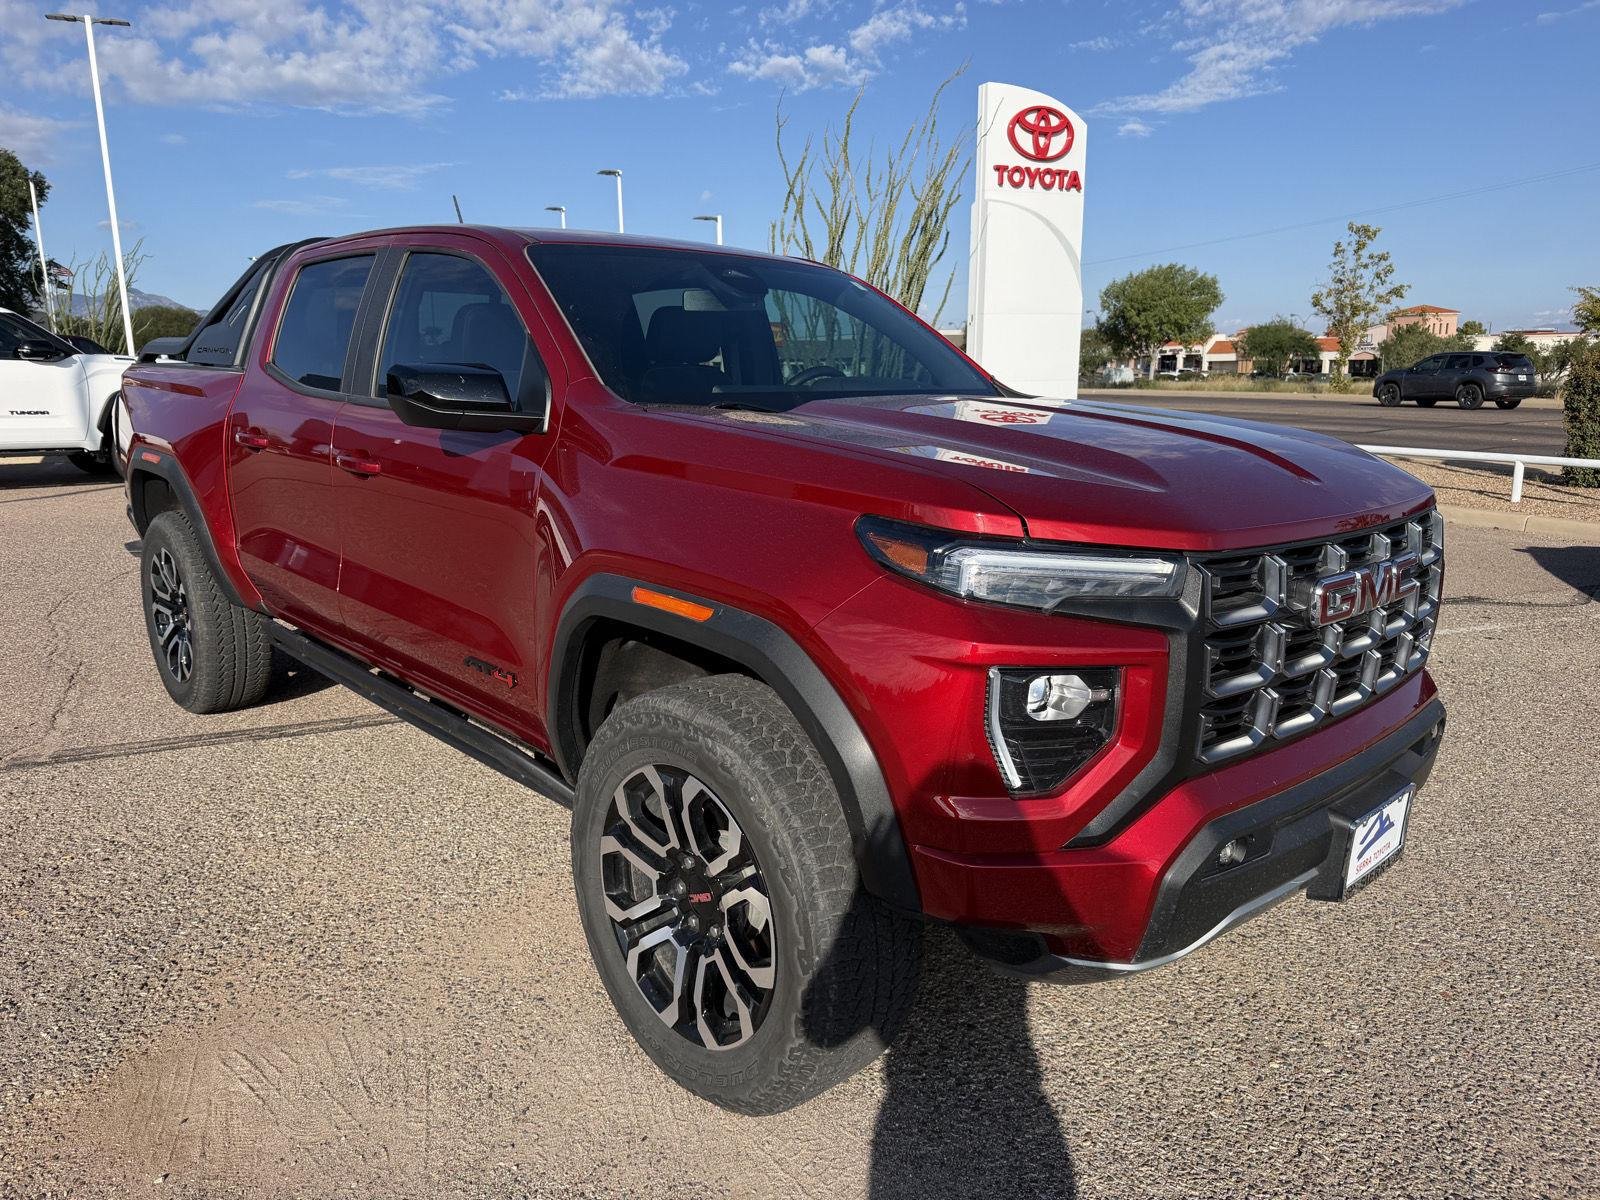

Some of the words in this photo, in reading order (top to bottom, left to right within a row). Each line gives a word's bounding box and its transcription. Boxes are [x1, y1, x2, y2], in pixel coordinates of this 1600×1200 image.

[993, 165, 1082, 193] TOYOTA
[1310, 551, 1420, 626] GMC
[464, 656, 518, 689] AT4
[688, 892, 712, 903] GMC
